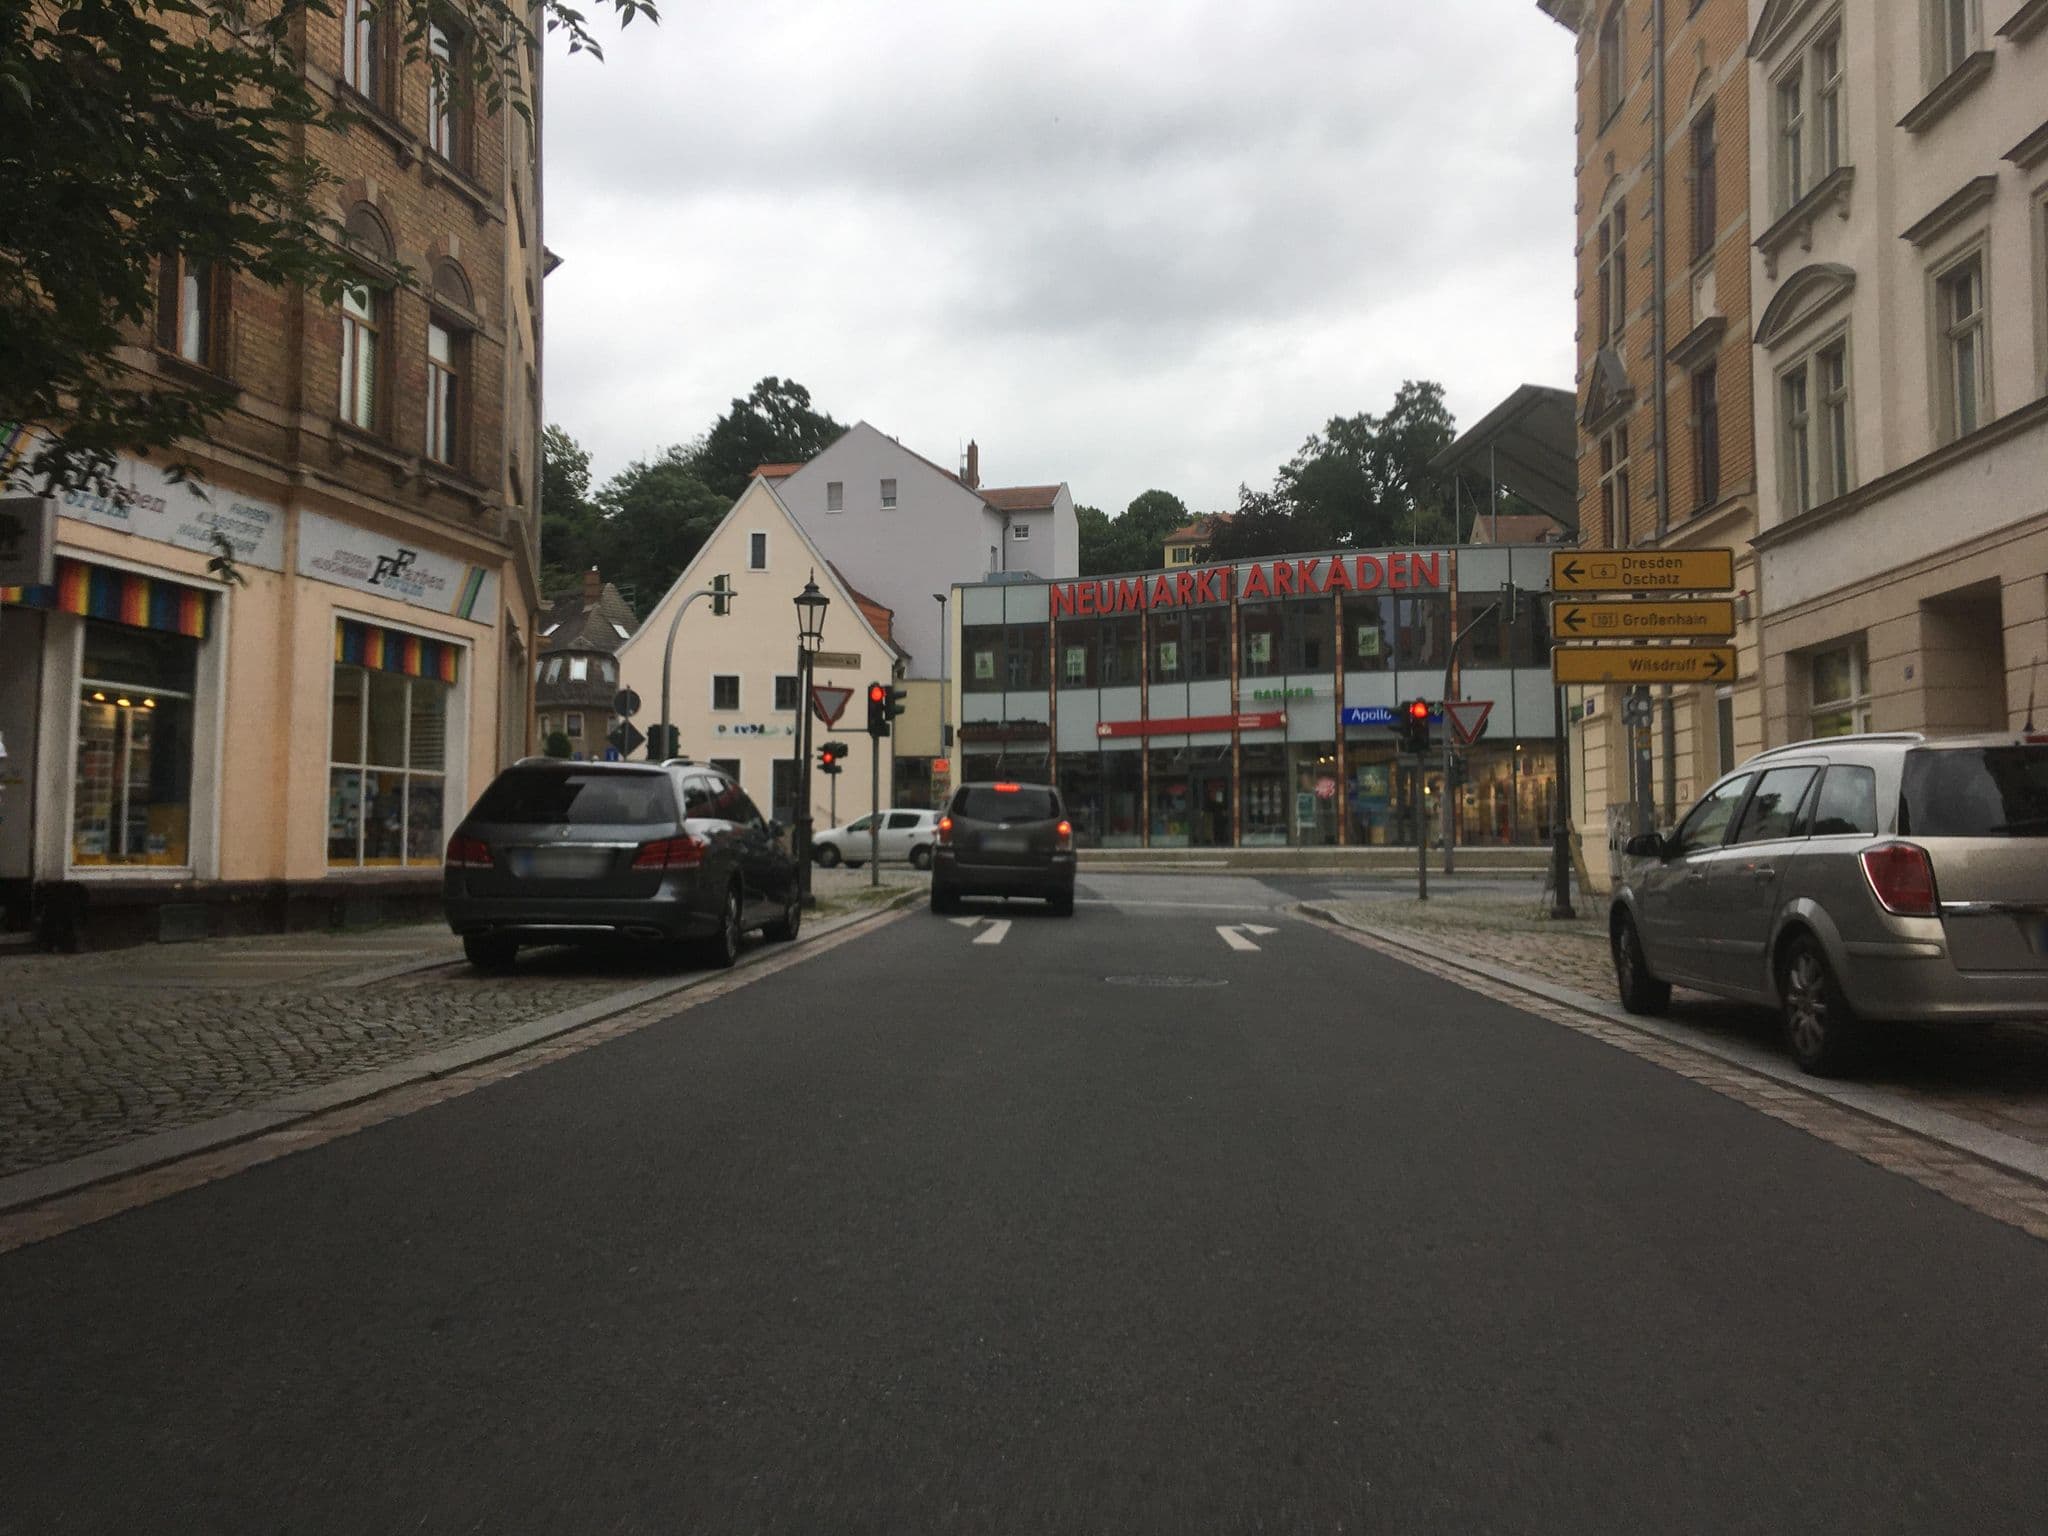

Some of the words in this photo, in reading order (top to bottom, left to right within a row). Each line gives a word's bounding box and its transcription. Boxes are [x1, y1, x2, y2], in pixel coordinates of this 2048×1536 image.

[1621, 556, 1683, 570] Dresden
[1600, 569, 1608, 577] 6
[1622, 572, 1680, 585] Oschatz
[1050, 565, 1234, 617] NEUMARKT
[1242, 551, 1441, 598] ARKADEN
[1623, 612, 1708, 626] Großenhain
[1629, 657, 1697, 673] Wilsdruff
[1351, 708, 1392, 723] Apollo
